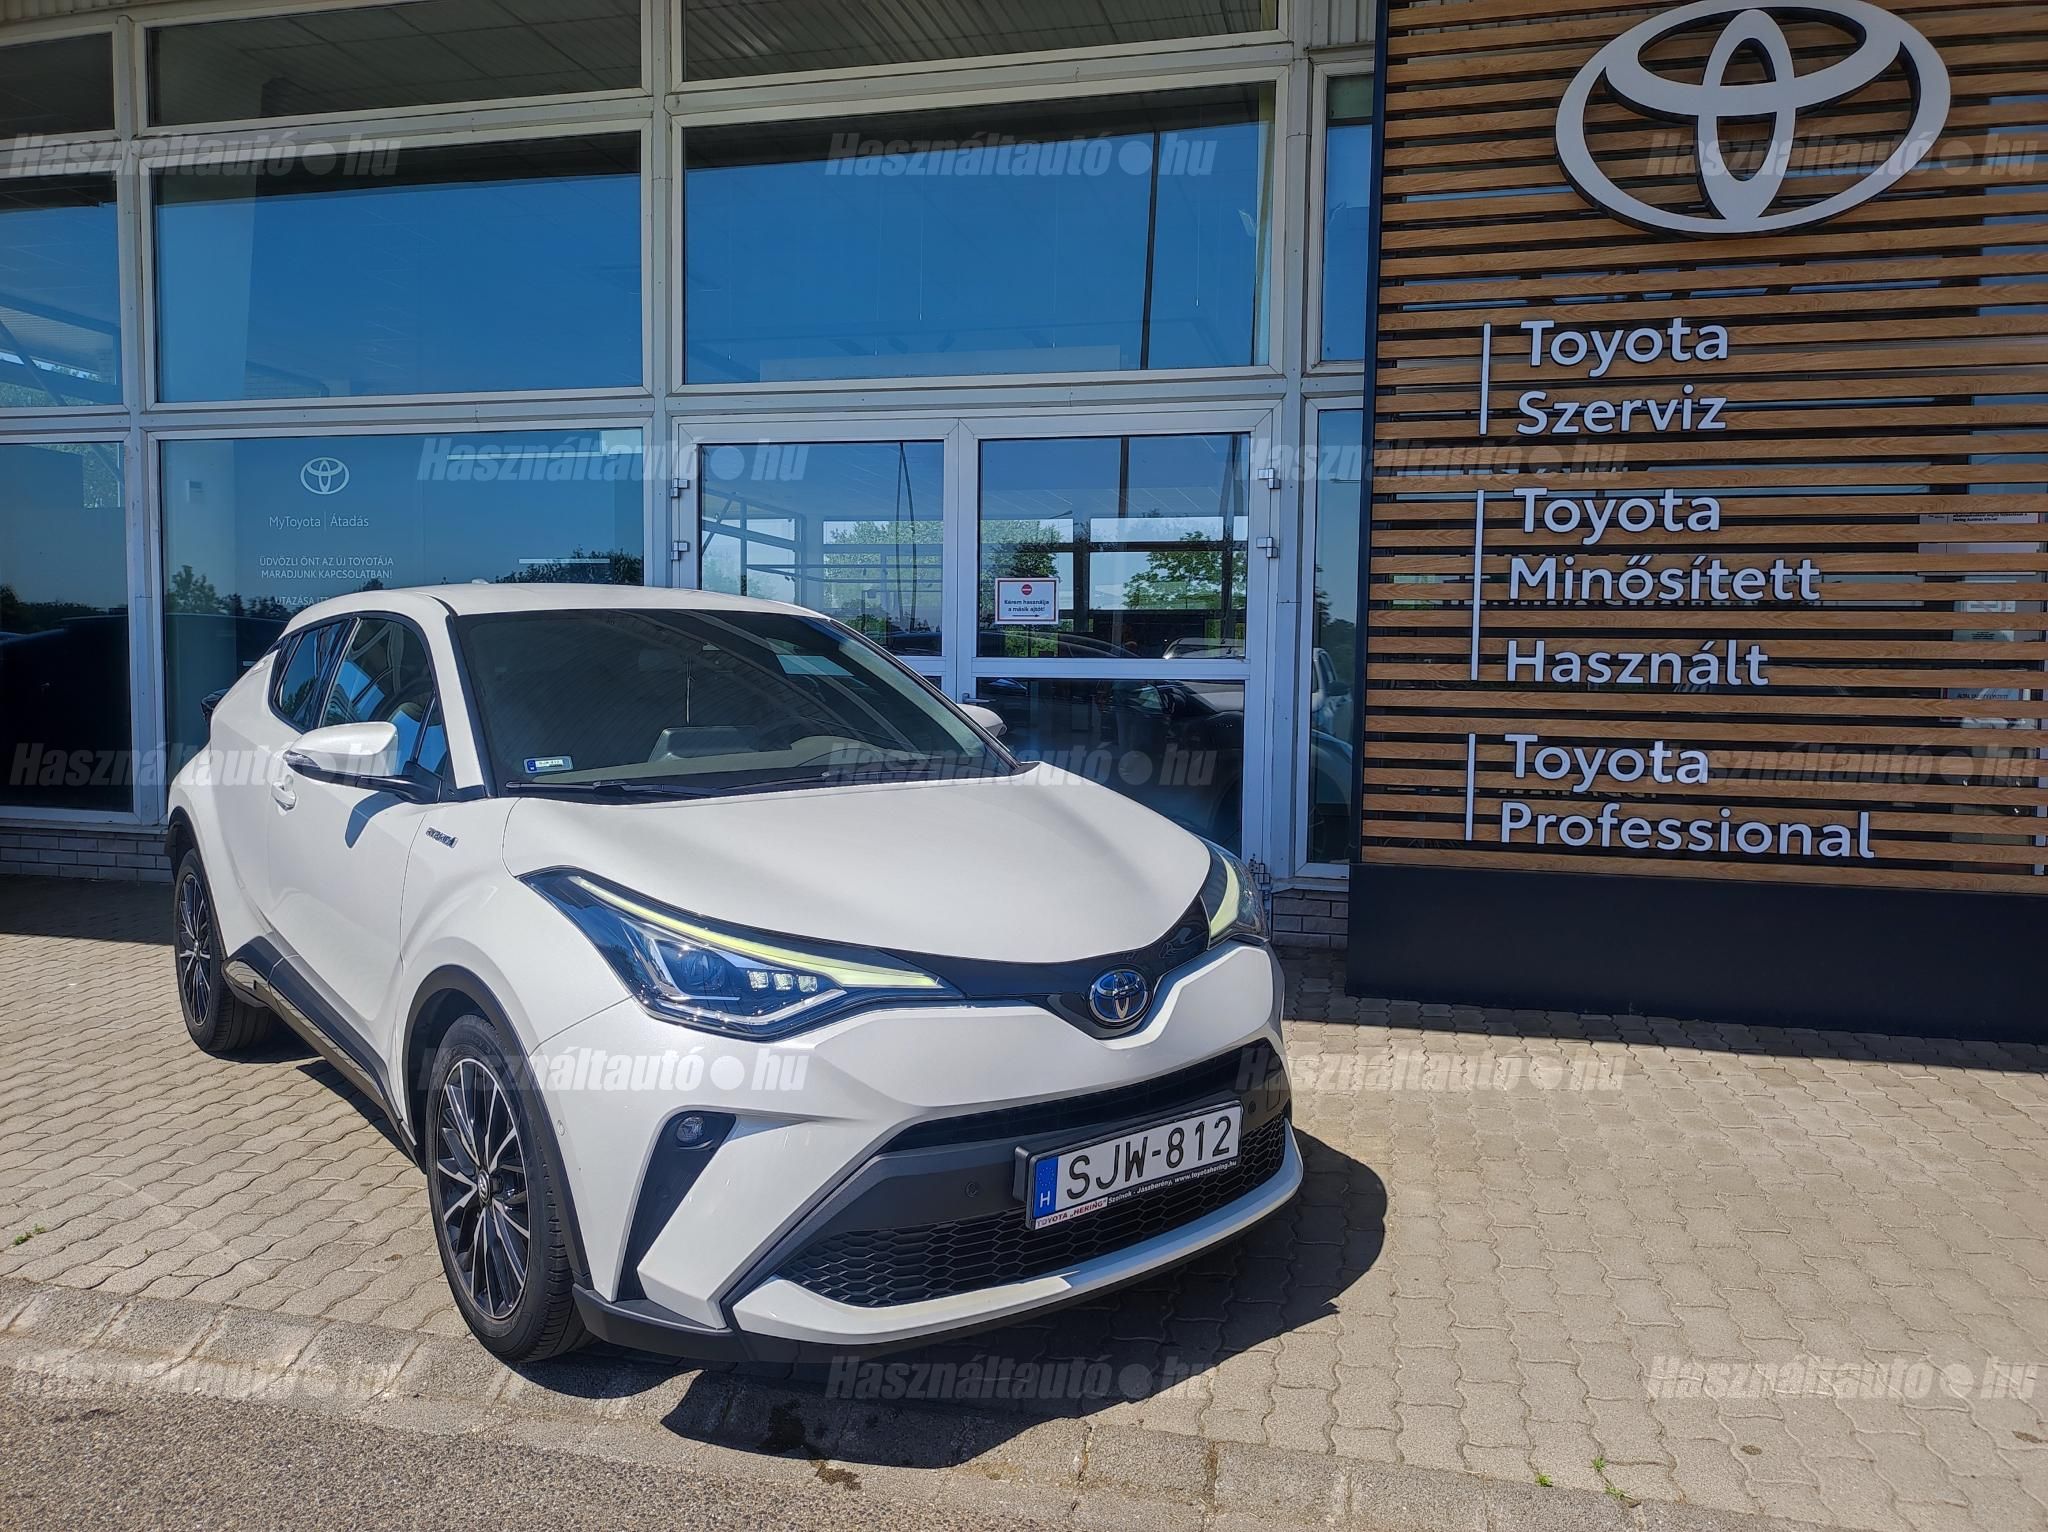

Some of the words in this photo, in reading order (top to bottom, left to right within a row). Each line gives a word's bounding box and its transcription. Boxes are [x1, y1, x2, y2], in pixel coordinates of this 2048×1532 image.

[1519, 317, 1729, 378] Toyota
[1515, 384, 1727, 436] Szerviz
[269, 515, 321, 530] MyToyota
[330, 513, 369, 527] Átadás
[1513, 487, 1721, 545] Toyota
[322, 557, 333, 566] AZ
[1509, 554, 1821, 602] Minősített
[1506, 638, 1769, 686] Használt
[1504, 732, 1709, 793] Toyota
[1500, 801, 1875, 859] Professional
[1066, 1115, 1232, 1200] SJW-812
[1037, 1212, 1068, 1227] TOYOTA
[1039, 1190, 1051, 1207] H
